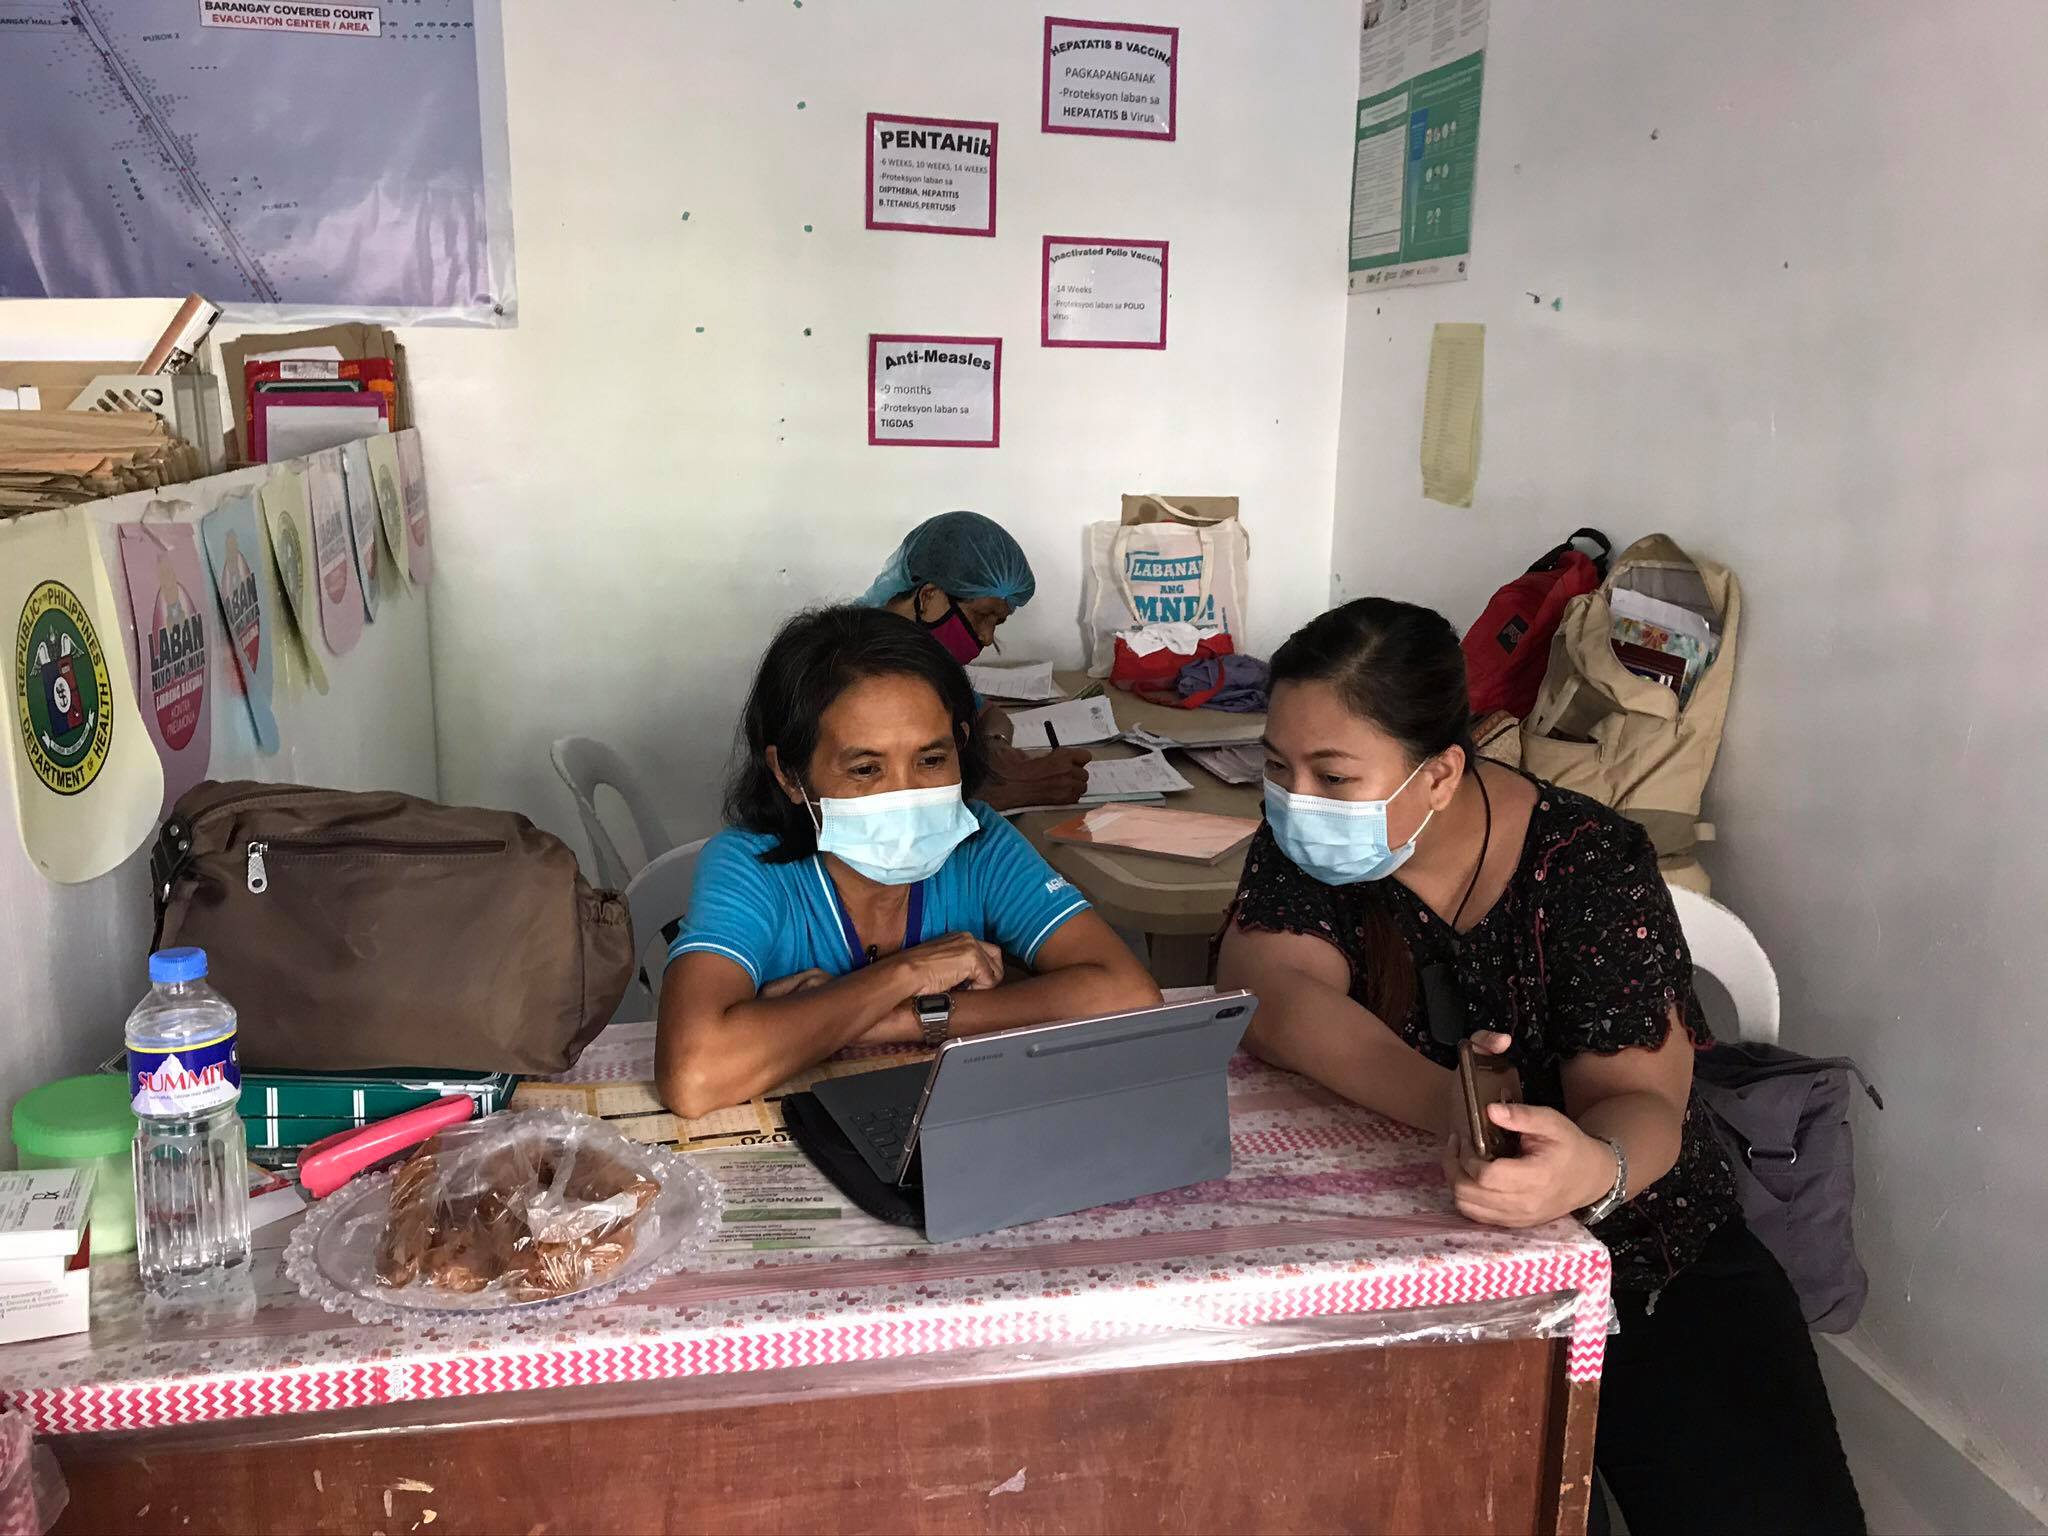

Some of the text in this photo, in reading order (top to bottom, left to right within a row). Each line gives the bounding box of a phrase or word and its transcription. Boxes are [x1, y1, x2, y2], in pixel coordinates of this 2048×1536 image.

[205, 1, 374, 20] BARANGAY COVERED COURT
[212, 14, 283, 26] EVACUATION
[286, 18, 330, 29] CENTER
[339, 22, 369, 32] AREA
[1050, 40, 1112, 56] HEPATATIS
[1115, 40, 1123, 50] B
[1065, 67, 1156, 84] PAGKAPANGANAK
[1059, 87, 1160, 105] -Proteksyon laban sa
[1063, 106, 1155, 122] HEPATATIS B Virus
[880, 130, 991, 157] PENTAHib
[1050, 248, 1162, 267] Inactivated Polio Vaccin
[885, 350, 991, 370] Anti-Measles
[893, 385, 932, 395] months
[881, 403, 969, 414] -Proteksyon laban sa
[881, 418, 914, 428] TIGDAS
[1134, 561, 1201, 577] LABANA
[1160, 585, 1184, 594] ANG
[19, 588, 101, 697] REPUBLIC PHILIPPINES
[147, 612, 204, 673] LABAN
[22, 717, 86, 788] DEPARTMENT
[93, 682, 110, 760] HEALTH
[138, 1060, 227, 1092] SUMMIT
